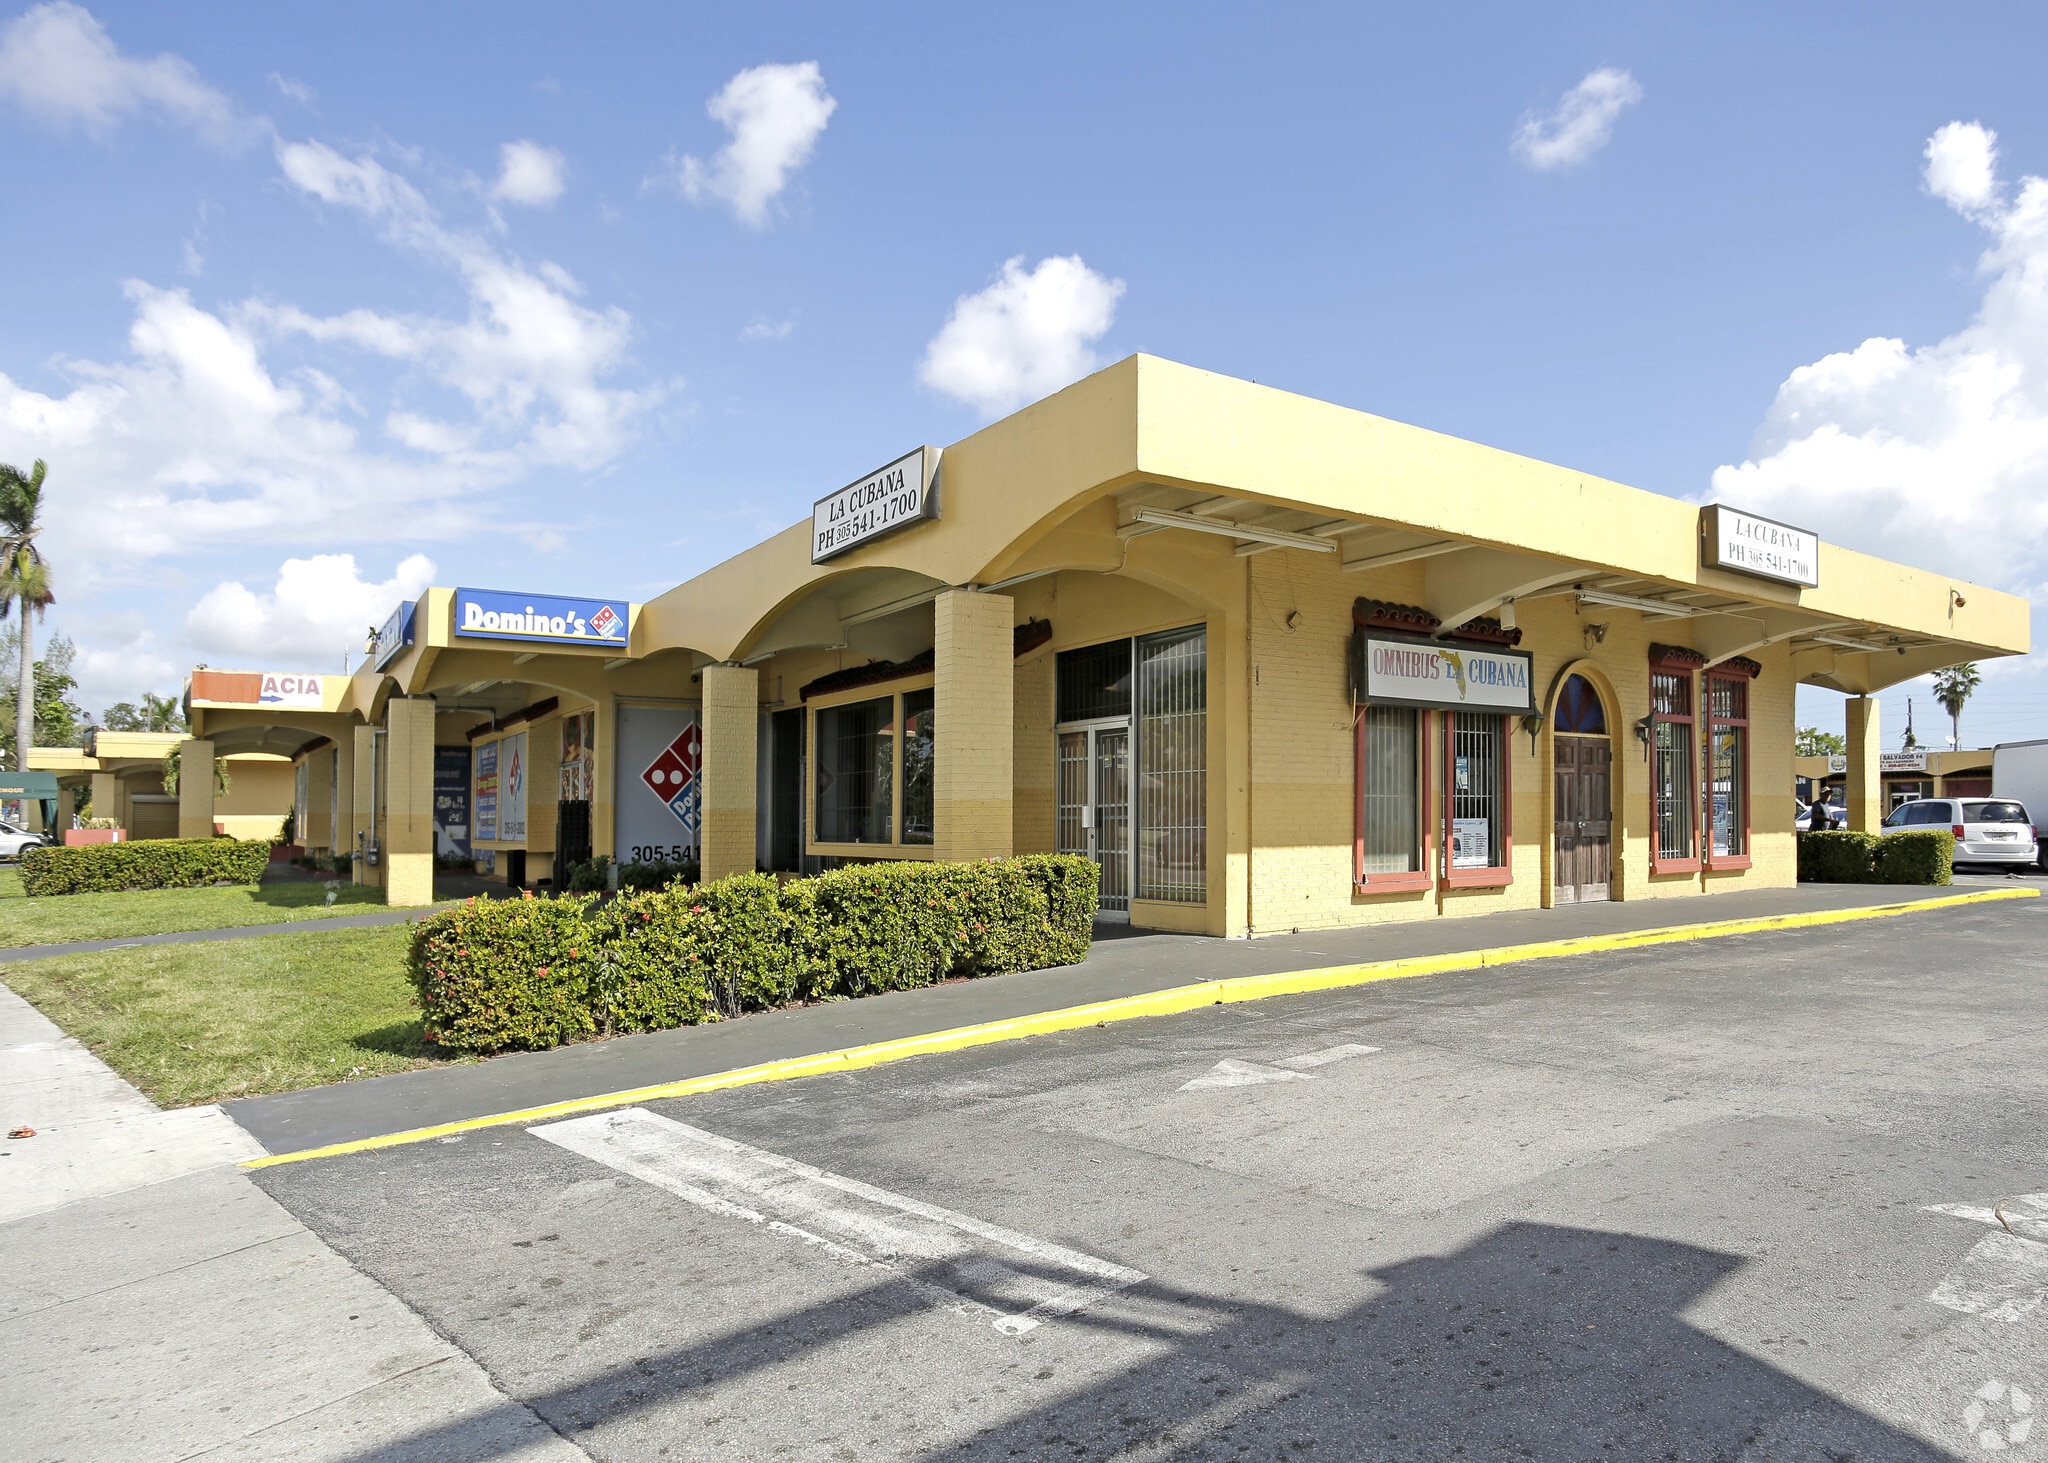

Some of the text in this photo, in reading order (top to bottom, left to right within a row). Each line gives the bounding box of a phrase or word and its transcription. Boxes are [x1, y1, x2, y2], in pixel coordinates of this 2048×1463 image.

[829, 468, 905, 522] LA CUBANA
[817, 489, 917, 552] PH 305 541-1700
[1736, 518, 1800, 551] LA CUBANA
[1729, 542, 1809, 577] PH 305 541-1700
[464, 602, 586, 635] Domino's
[1373, 648, 1440, 679] OMNIBUS
[1469, 658, 1527, 688] CUBANA
[263, 677, 320, 695] ACIA
